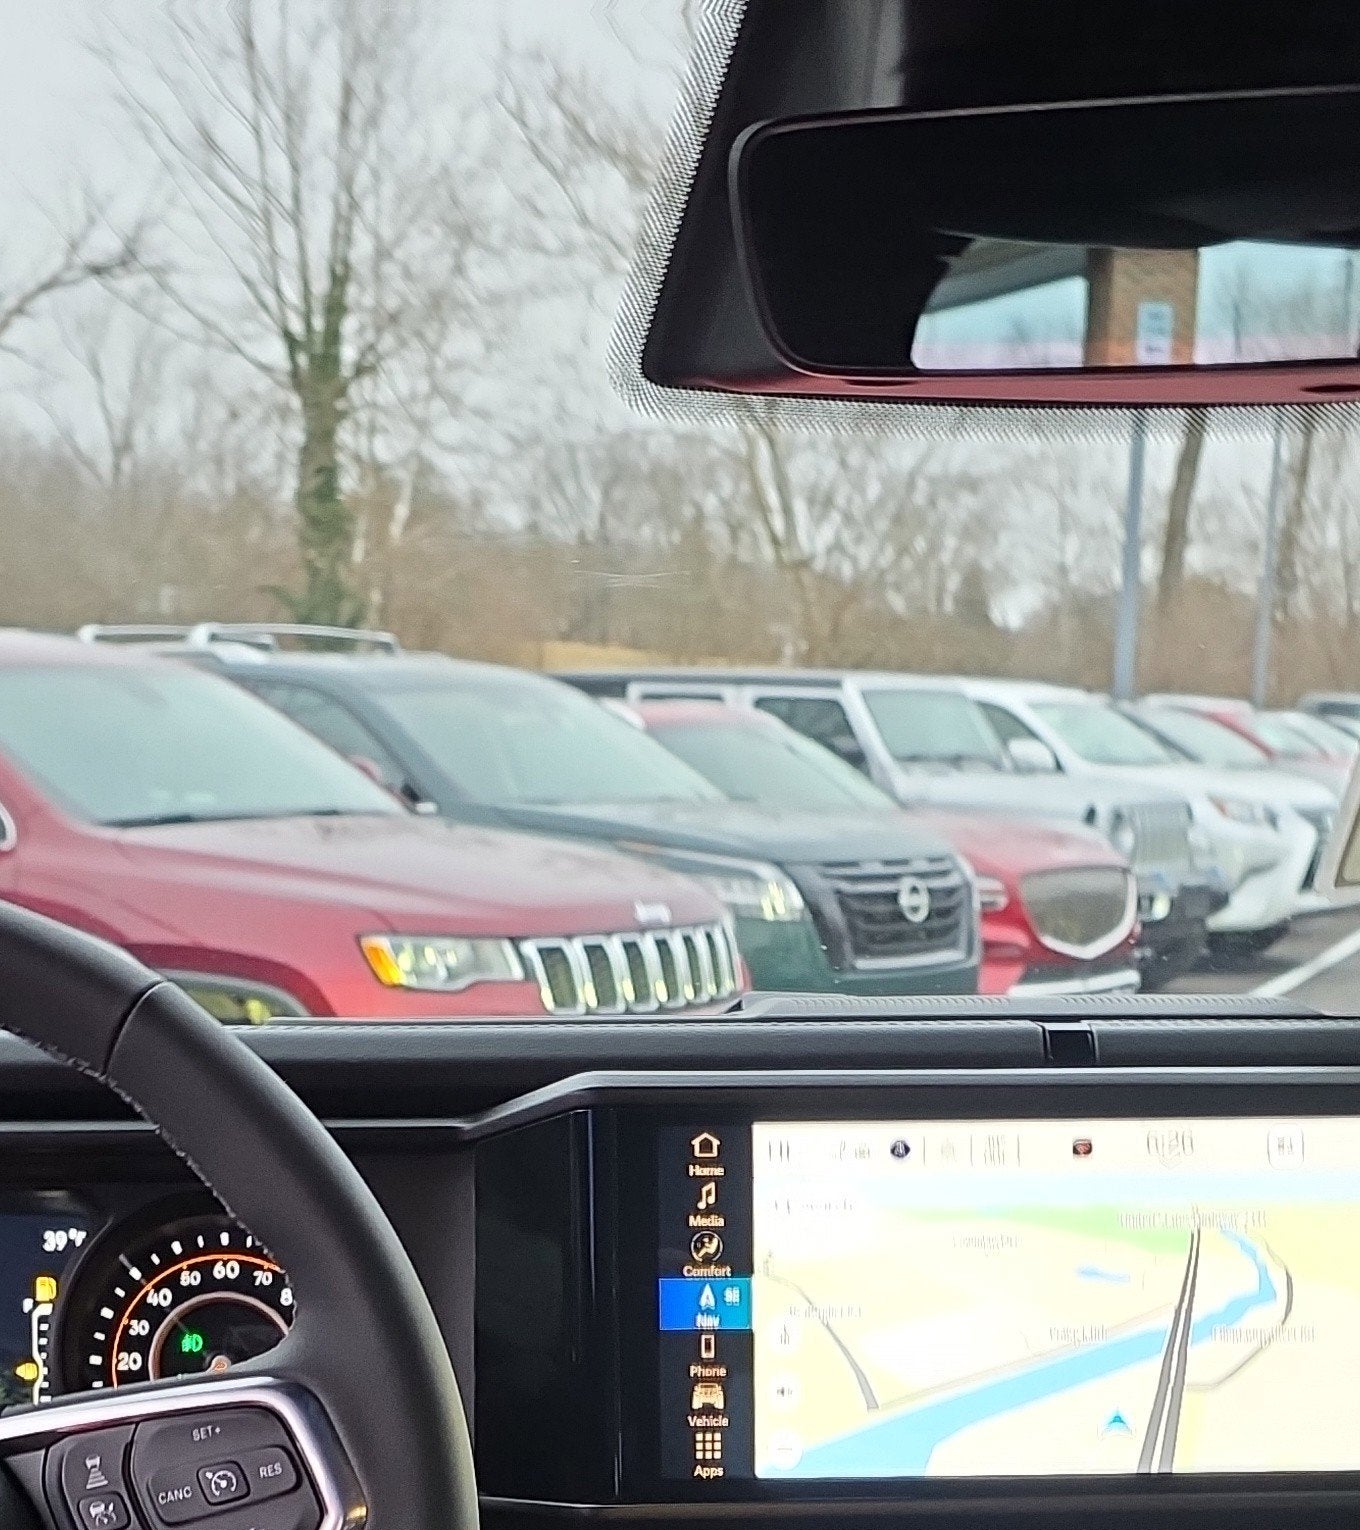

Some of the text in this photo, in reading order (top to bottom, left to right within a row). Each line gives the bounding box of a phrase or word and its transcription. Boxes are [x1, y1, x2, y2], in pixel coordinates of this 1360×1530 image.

[689, 1165, 725, 1177] Home
[689, 1215, 725, 1227] Media
[179, 1270, 202, 1287] 50
[212, 1260, 240, 1280] 60
[252, 1270, 273, 1287] 70
[682, 1265, 732, 1278] Comfort
[146, 1287, 173, 1308] 40
[128, 1319, 150, 1336] 30
[116, 1351, 142, 1371] 20
[689, 1365, 727, 1378] Phone
[686, 1415, 730, 1428] Vehicle
[191, 1425, 222, 1442] SET+
[258, 1461, 283, 1479] RES
[693, 1464, 724, 1480] Apps
[157, 1485, 193, 1505] CANC
